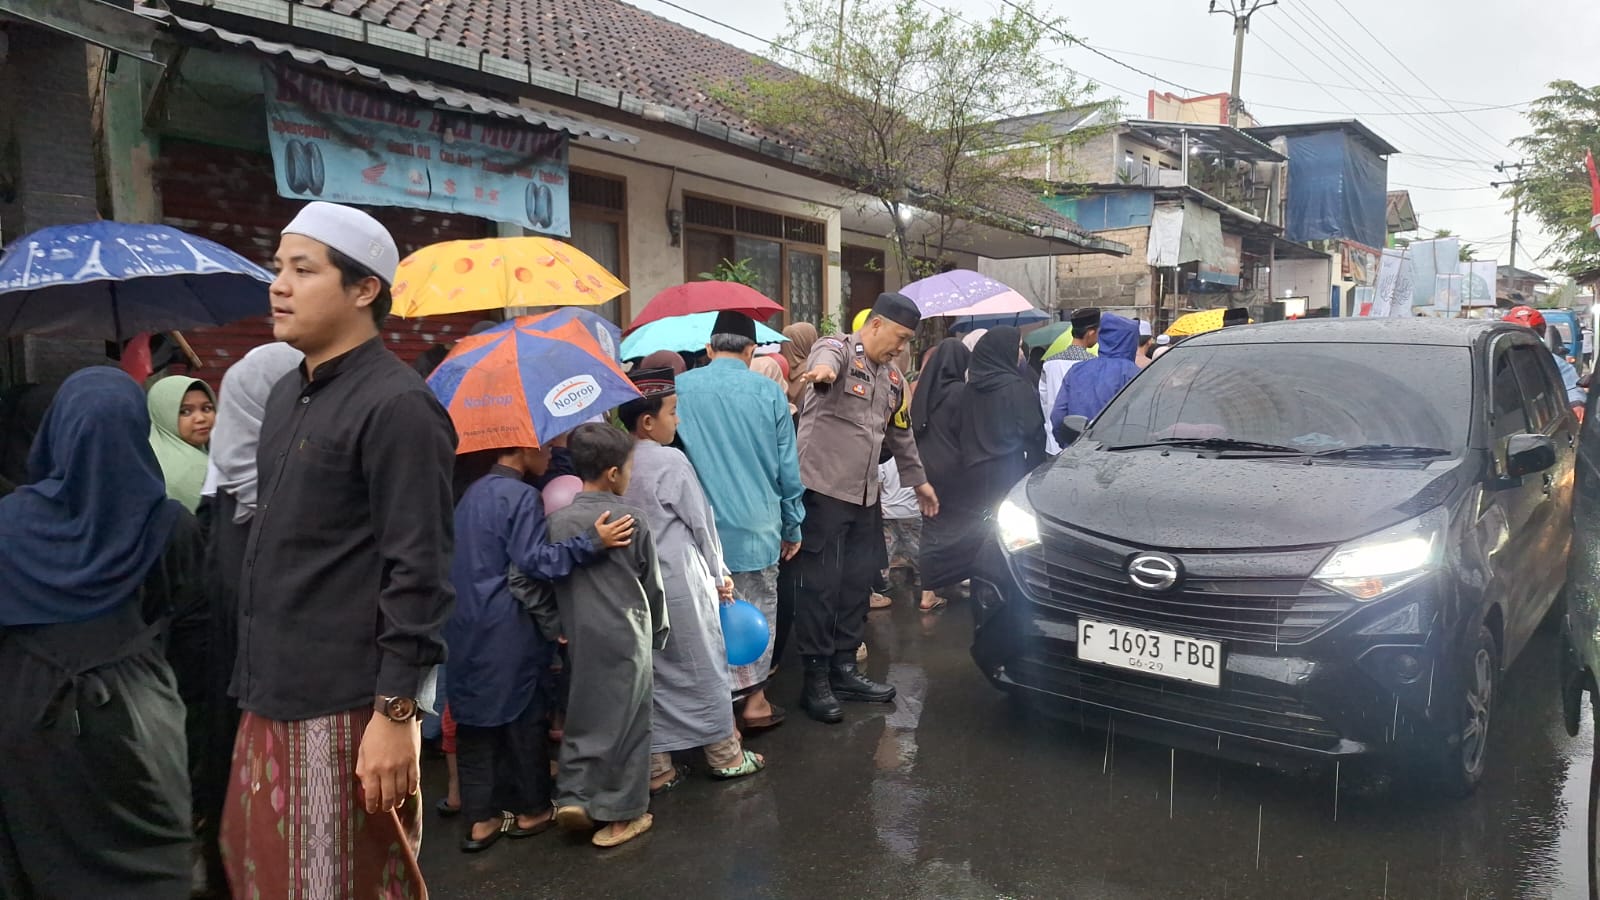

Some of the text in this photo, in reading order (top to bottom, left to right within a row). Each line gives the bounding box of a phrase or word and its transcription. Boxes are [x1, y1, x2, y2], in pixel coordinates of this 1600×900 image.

[464, 393, 513, 408] NoDrop
[553, 383, 594, 411] NoDrop
[1083, 624, 1215, 669] F 1693 FBQ
